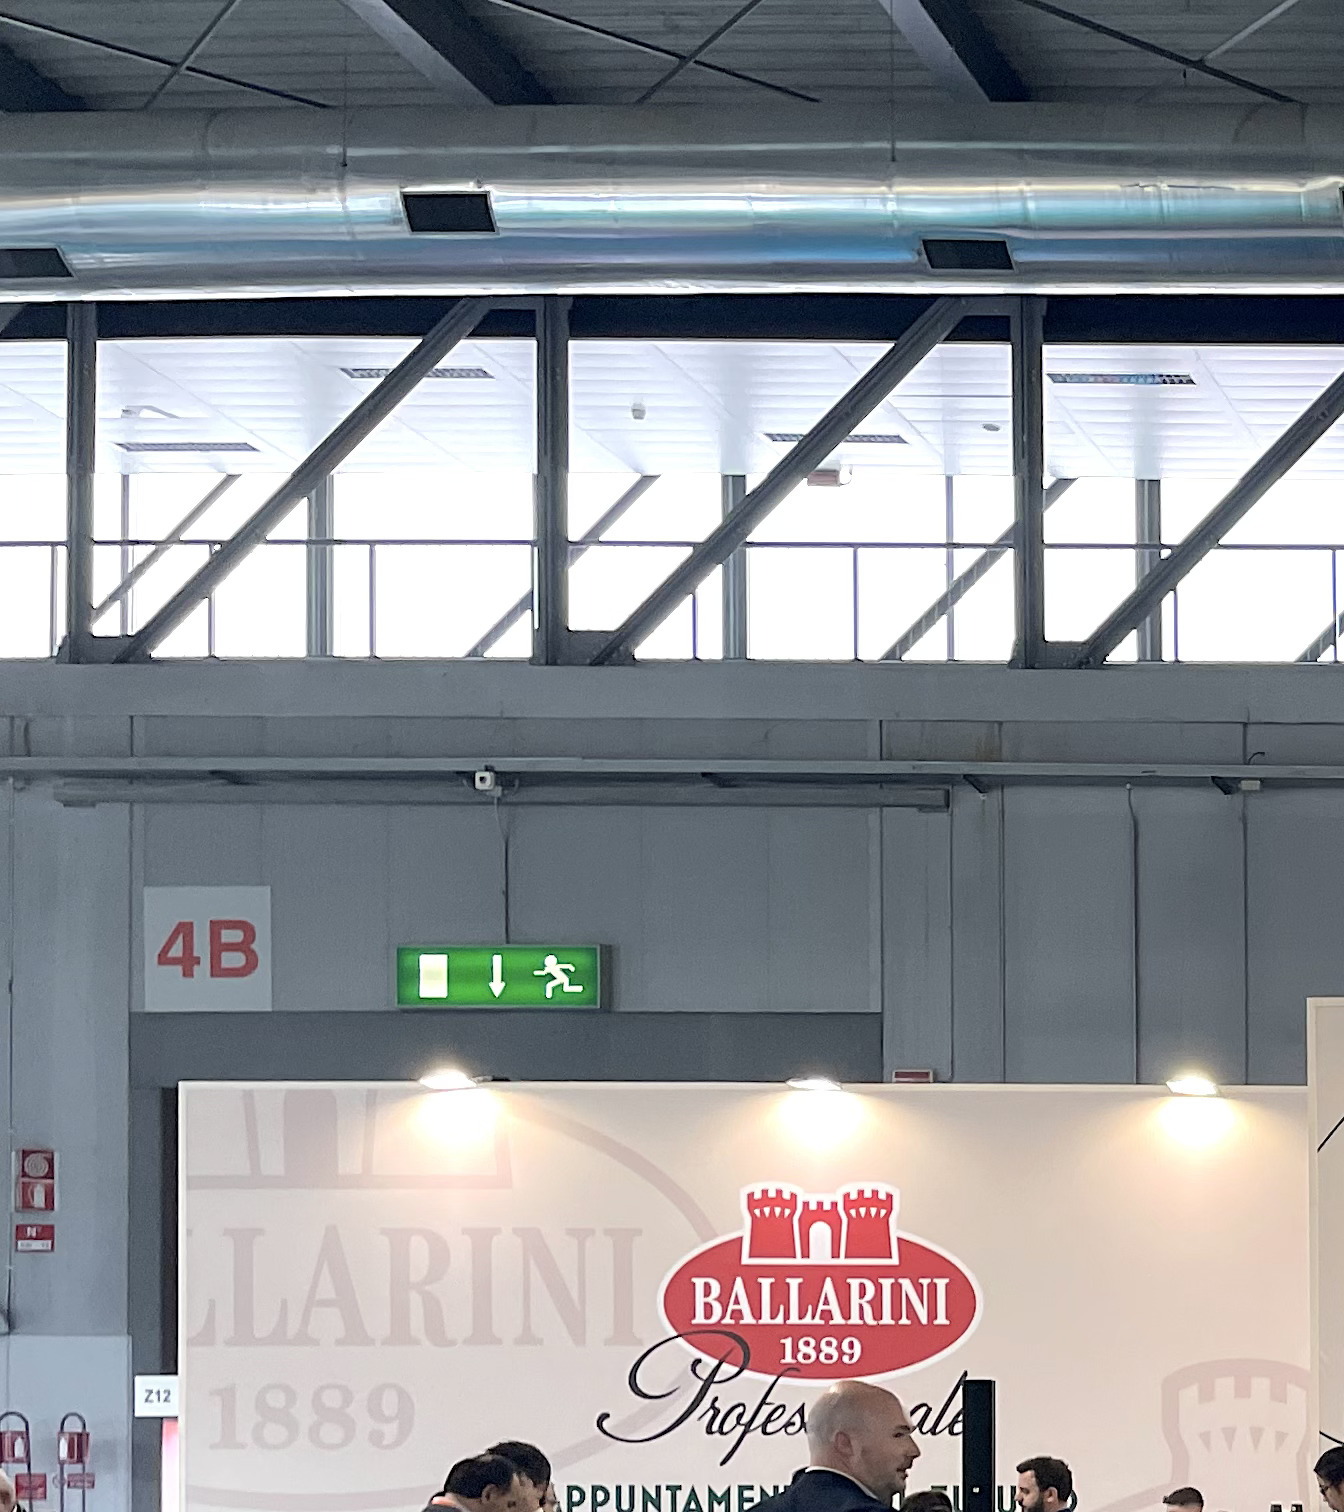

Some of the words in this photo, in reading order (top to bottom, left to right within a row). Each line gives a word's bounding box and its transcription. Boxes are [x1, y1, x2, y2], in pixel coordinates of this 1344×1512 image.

[157, 919, 259, 979] 4B
[690, 1277, 951, 1326] BALLARINI
[779, 1336, 862, 1365] 1889
[144, 1388, 172, 1404] Z12
[208, 1382, 417, 1451] 1889
